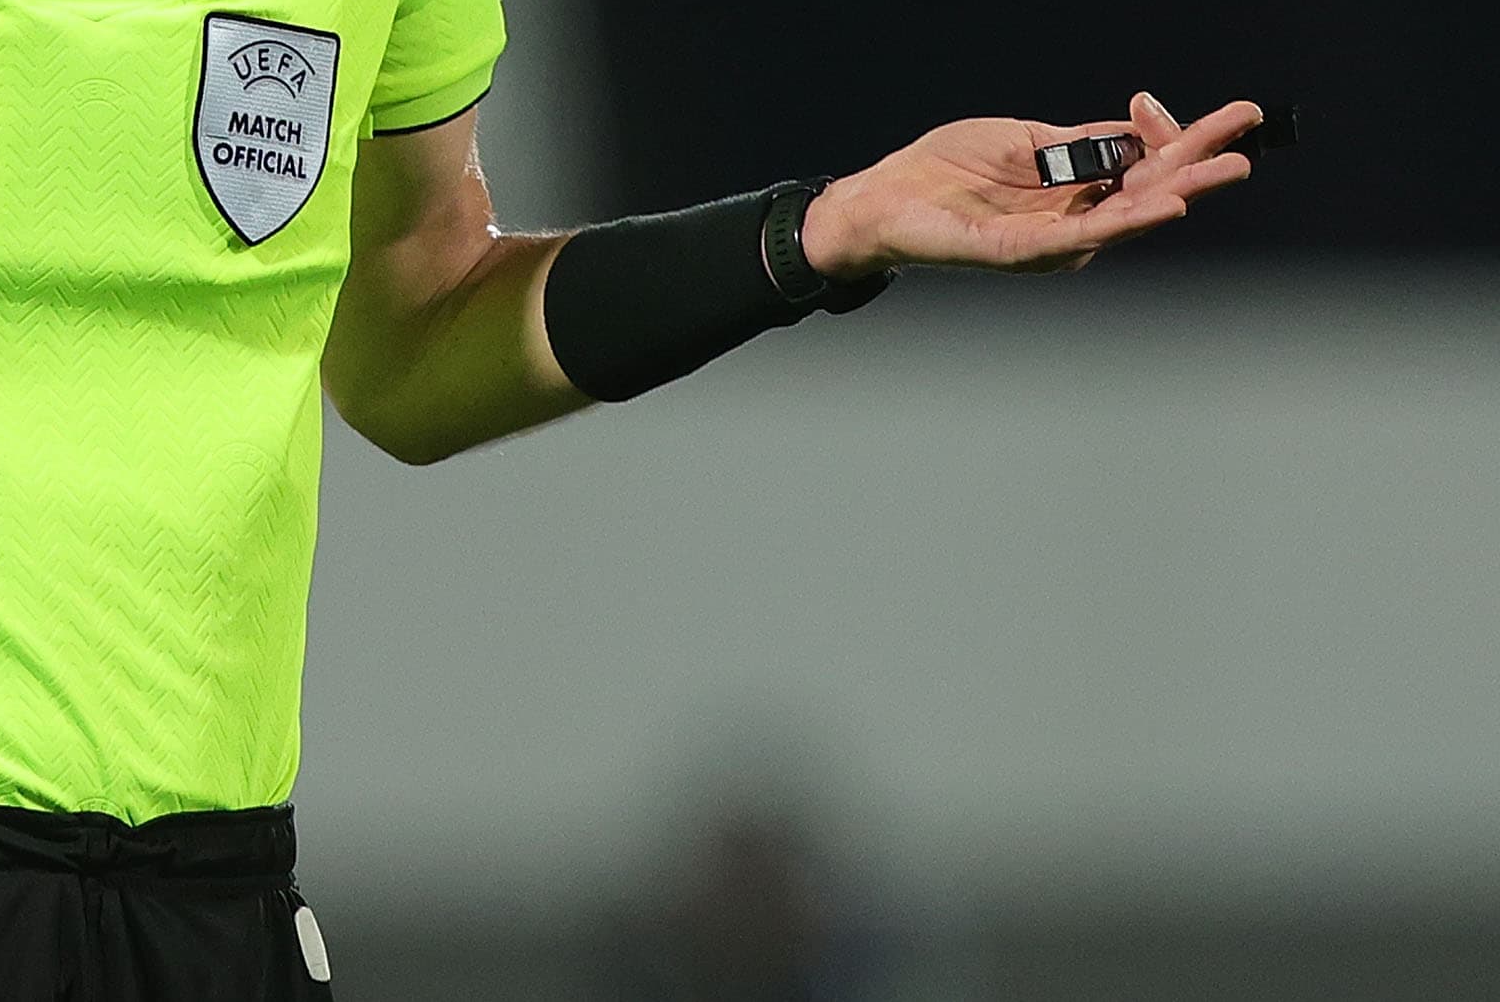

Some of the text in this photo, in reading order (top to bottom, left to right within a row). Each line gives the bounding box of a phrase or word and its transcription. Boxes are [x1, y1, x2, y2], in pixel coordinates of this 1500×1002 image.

[233, 48, 307, 93] UEFA
[229, 112, 302, 145] MATCH
[213, 142, 307, 179] OFFICIAL
